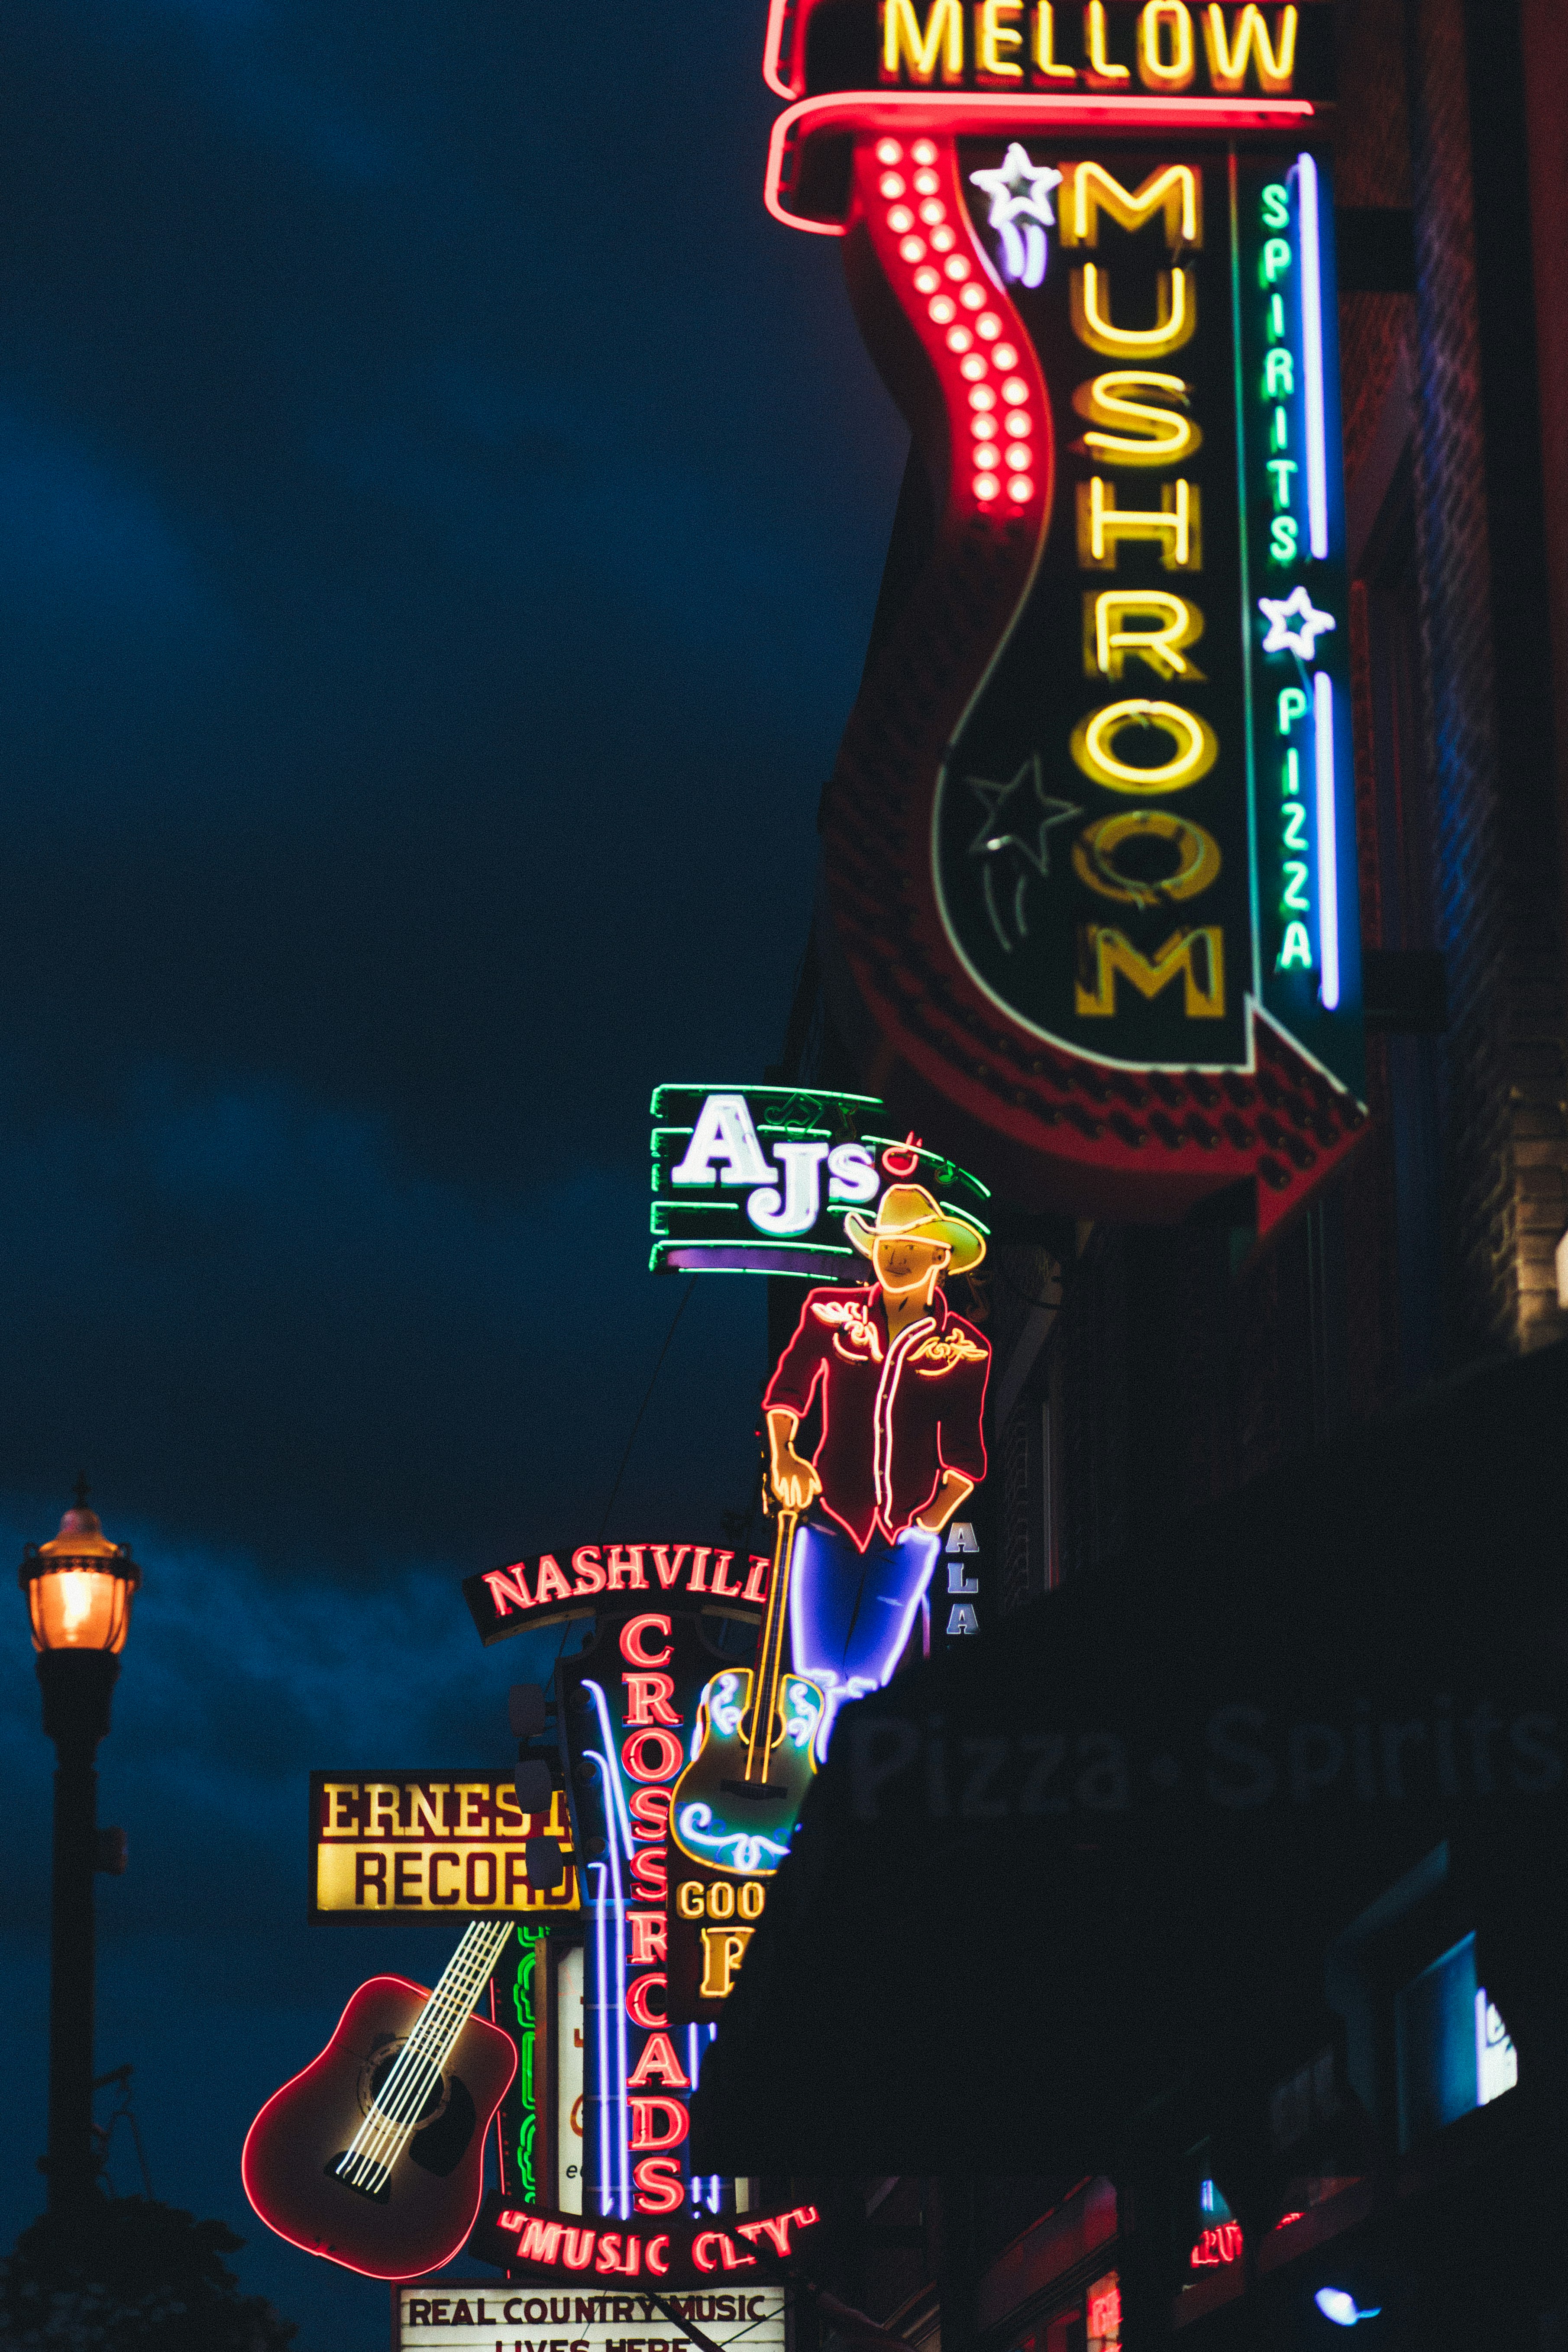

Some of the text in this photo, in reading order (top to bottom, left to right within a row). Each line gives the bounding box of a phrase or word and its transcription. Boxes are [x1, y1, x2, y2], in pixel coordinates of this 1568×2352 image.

[878, 0, 1298, 93] MELLOW
[1258, 184, 1298, 564] SPIRITS
[1057, 160, 1225, 1018] MUSHROOM
[1276, 687, 1313, 969] PIZZA
[409, 2298, 496, 2326] REAL
[503, 2296, 657, 2324] COUNTRY
